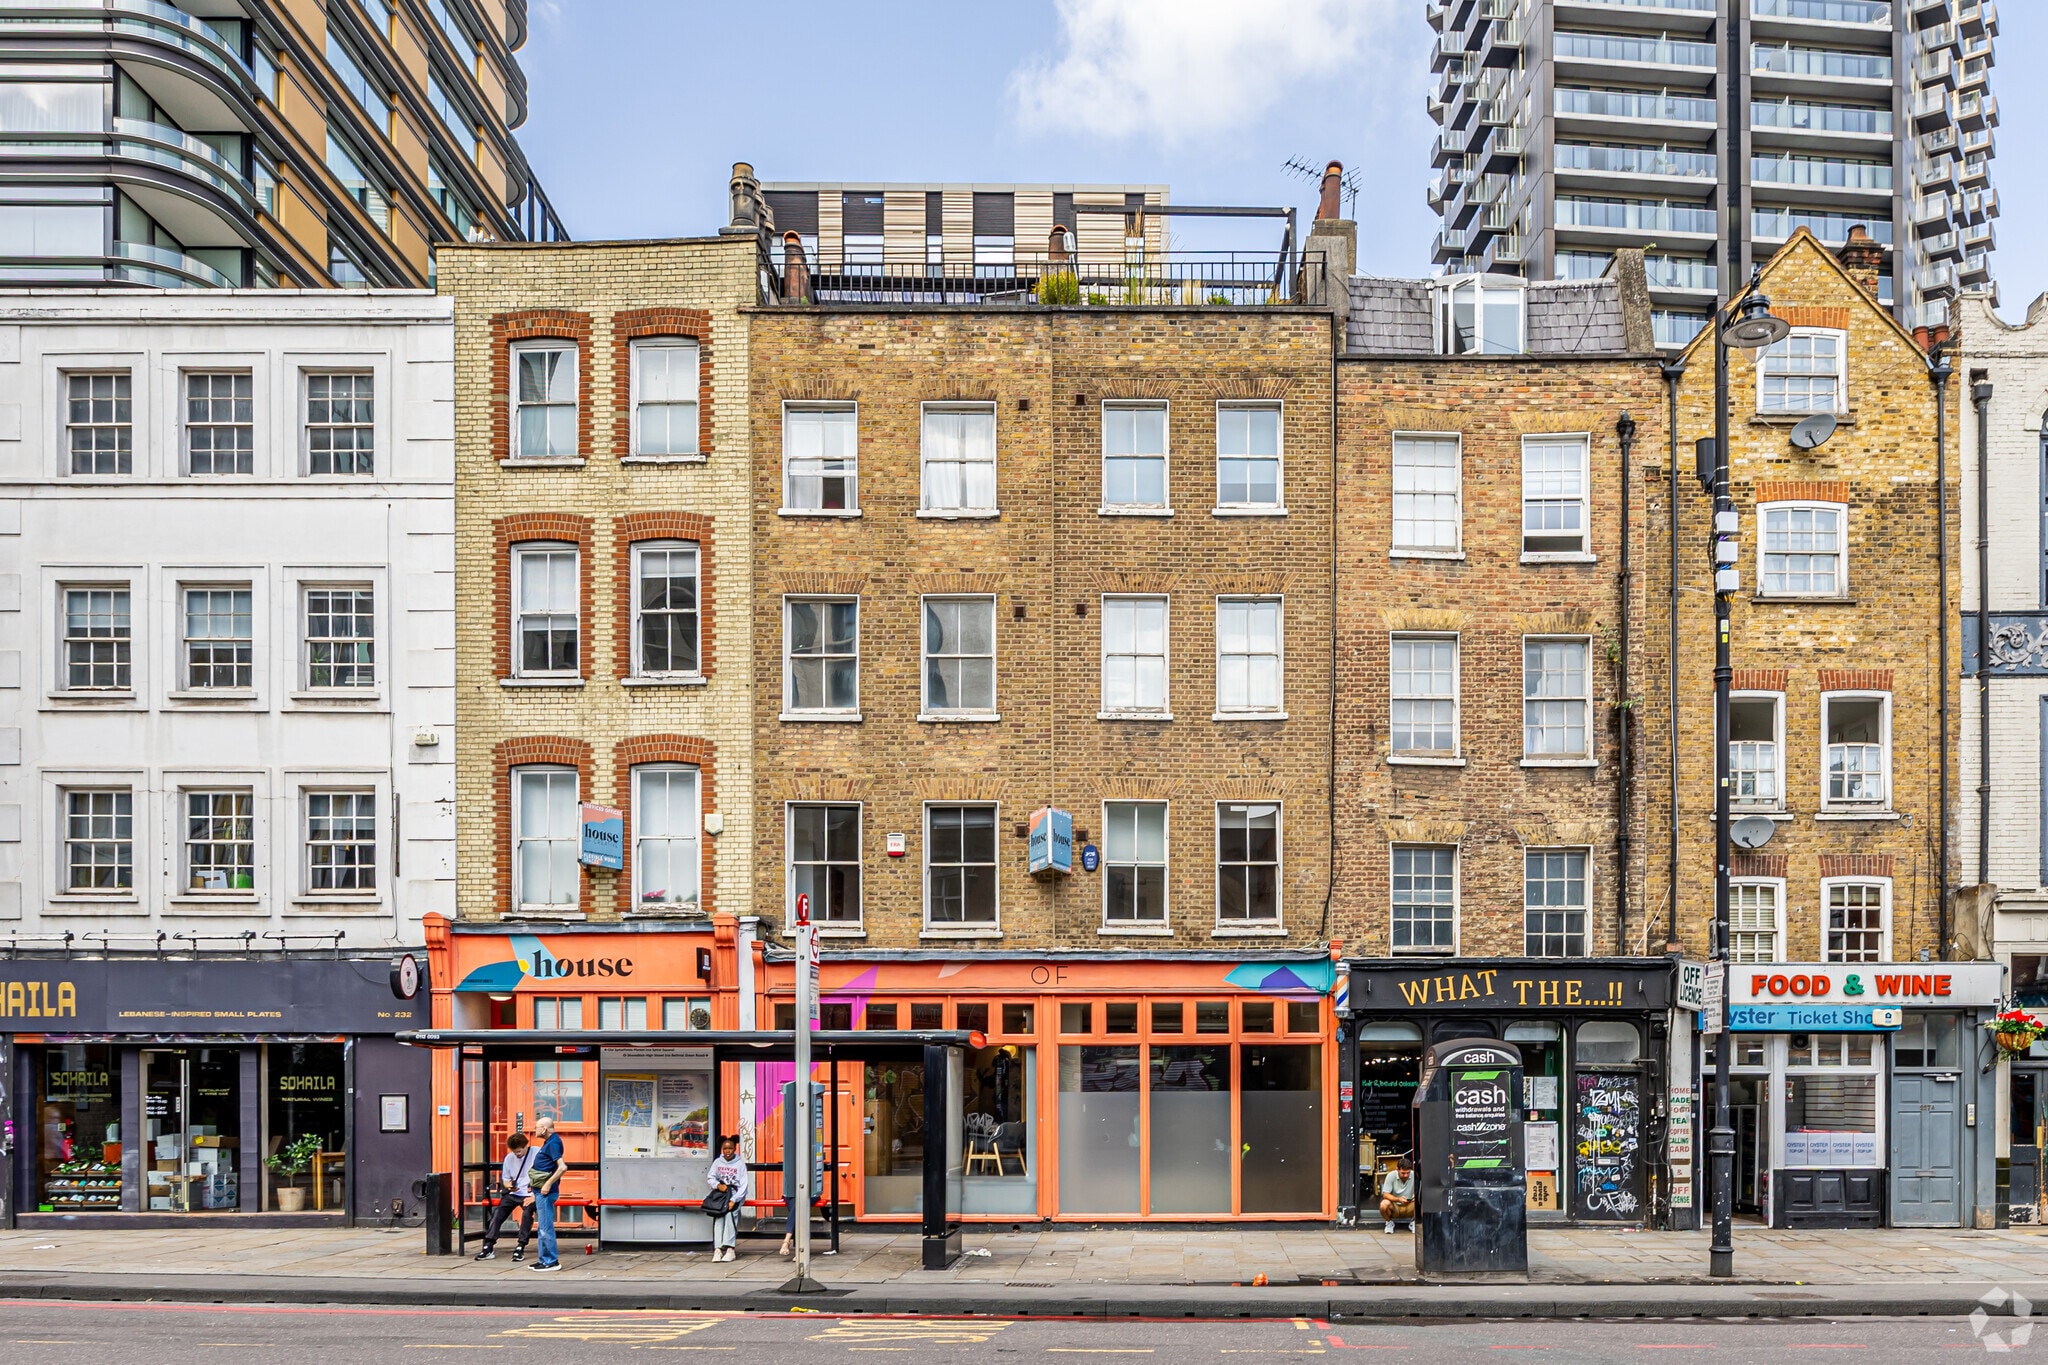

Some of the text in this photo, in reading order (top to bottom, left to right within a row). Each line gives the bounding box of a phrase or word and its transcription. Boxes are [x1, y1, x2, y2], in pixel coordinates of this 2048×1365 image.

[584, 824, 619, 843] house
[802, 897, 808, 917] F
[532, 950, 633, 977] house
[1031, 965, 1069, 985] OF
[1683, 966, 1701, 985] OFF
[1751, 974, 1952, 996] FOOD & WINE
[1398, 969, 1497, 1007] WHAT
[1680, 984, 1702, 1005] LICENCE
[0, 981, 77, 1017] AILA
[1788, 1011, 1838, 1025] Ticket
[1843, 1010, 1873, 1025] Sho
[1464, 1051, 1494, 1063] cash
[52, 1072, 109, 1086] SOHAILA
[280, 1076, 335, 1090] SOHAILA
[1455, 1085, 1506, 1105] cash
[1669, 1145, 1690, 1153] CARD
